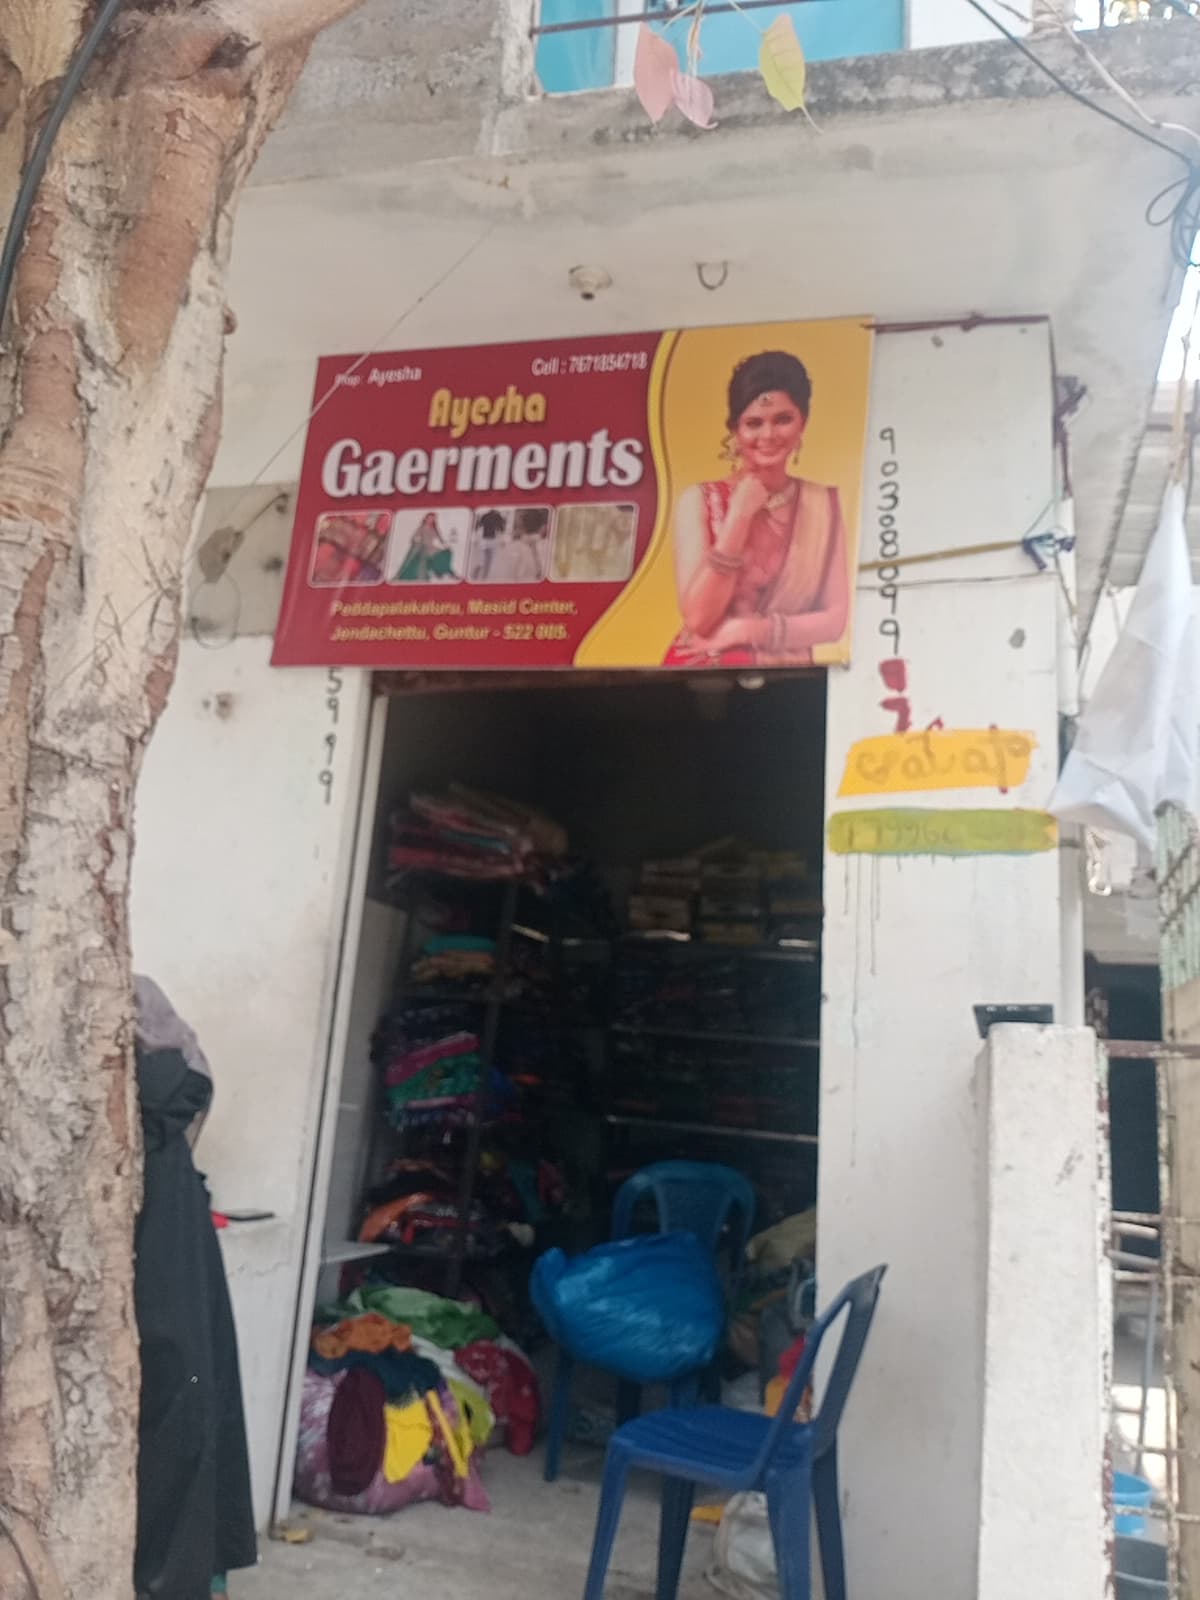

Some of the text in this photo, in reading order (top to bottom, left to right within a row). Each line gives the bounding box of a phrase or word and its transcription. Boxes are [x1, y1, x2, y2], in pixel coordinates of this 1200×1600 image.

[367, 366, 423, 387] Ayesha
[531, 357, 560, 376] Call
[427, 385, 547, 438] Ayesha
[321, 428, 644, 499] Gaerments
[433, 622, 489, 640] Guntur
[503, 624, 534, 641] 522
